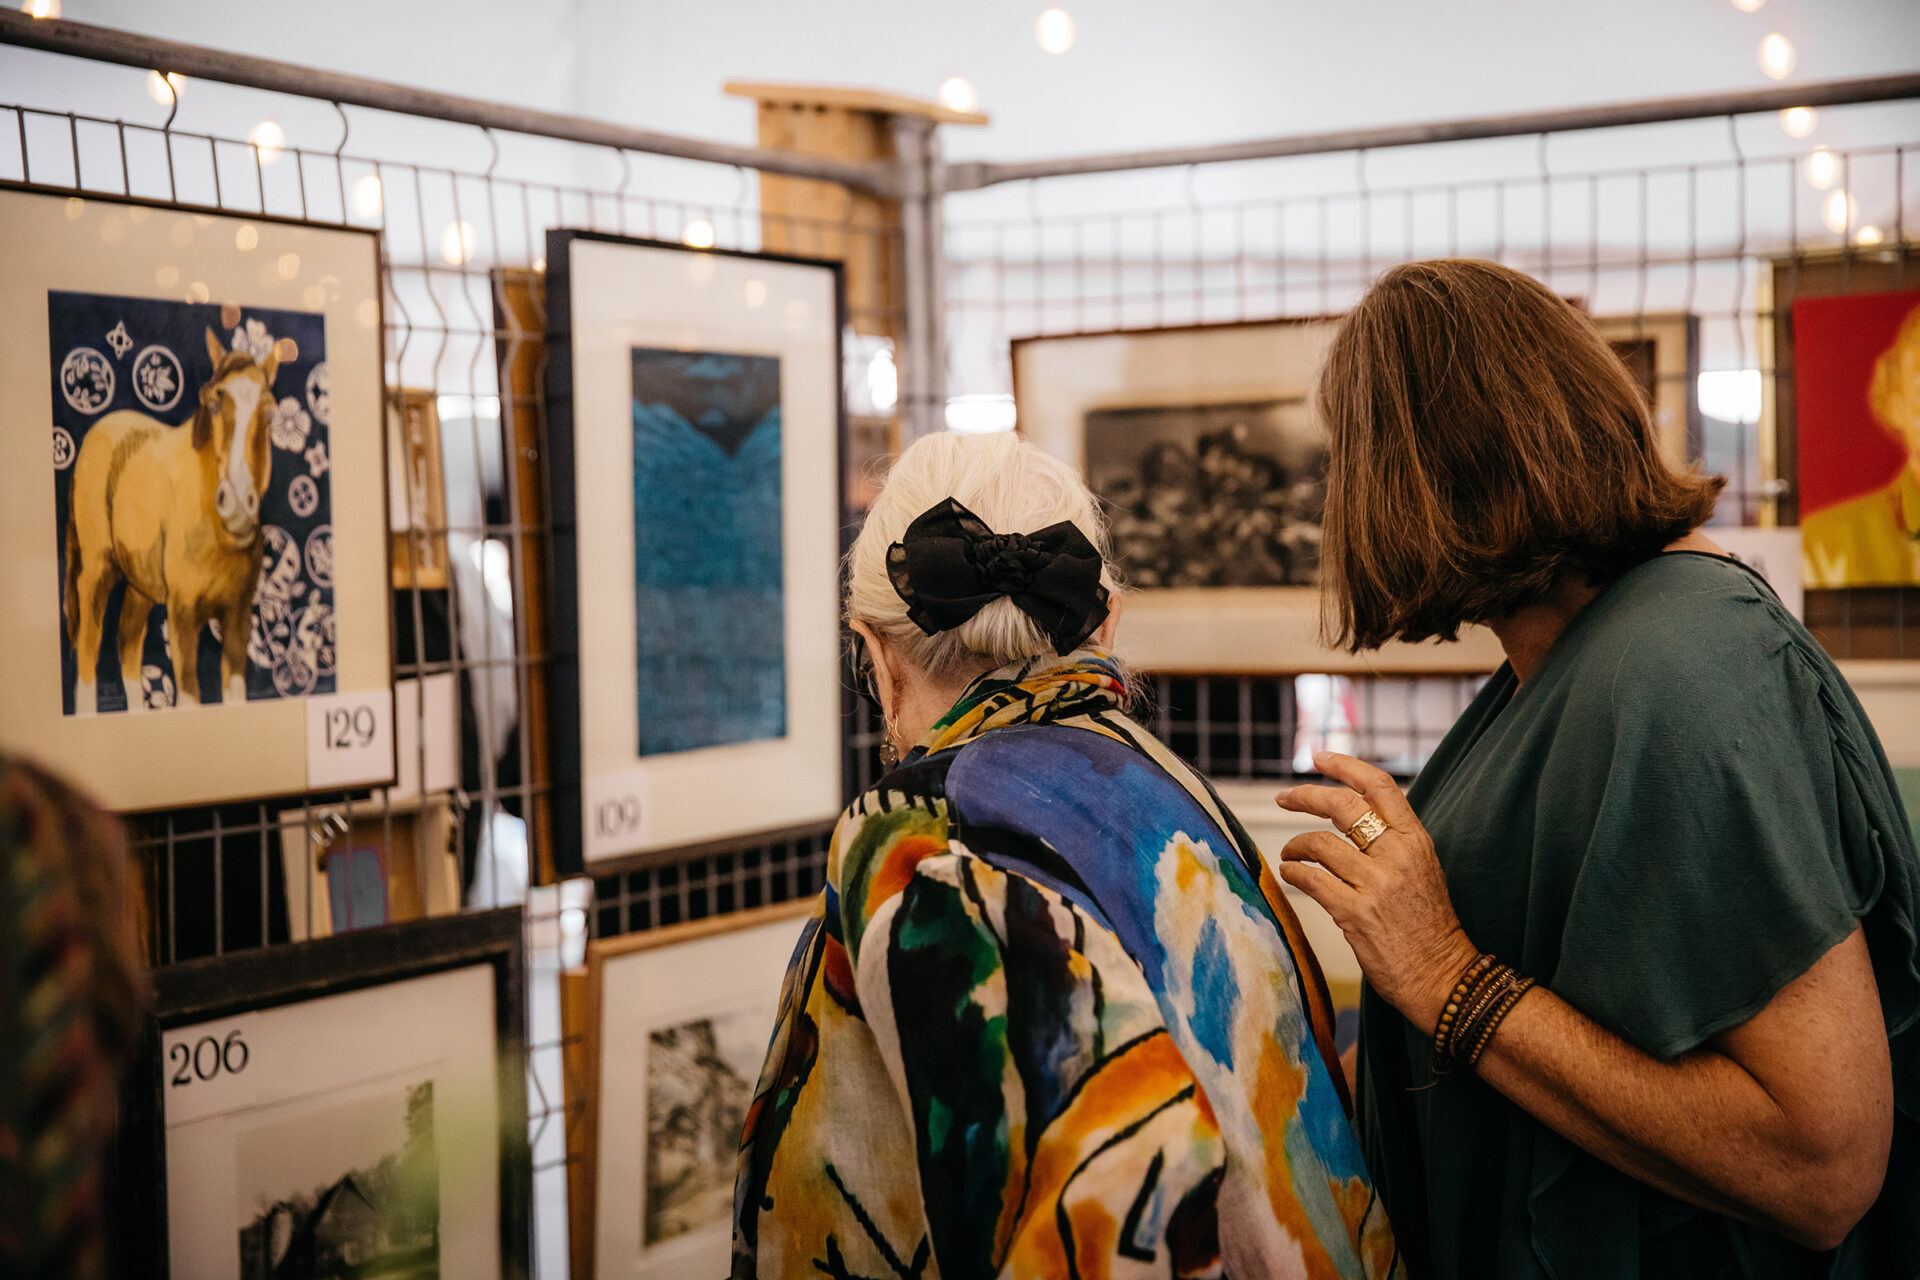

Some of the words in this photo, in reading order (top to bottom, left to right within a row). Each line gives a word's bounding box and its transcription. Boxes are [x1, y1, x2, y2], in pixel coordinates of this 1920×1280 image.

[325, 704, 376, 750] 129
[595, 794, 641, 838] 109
[170, 1030, 249, 1087] 206
